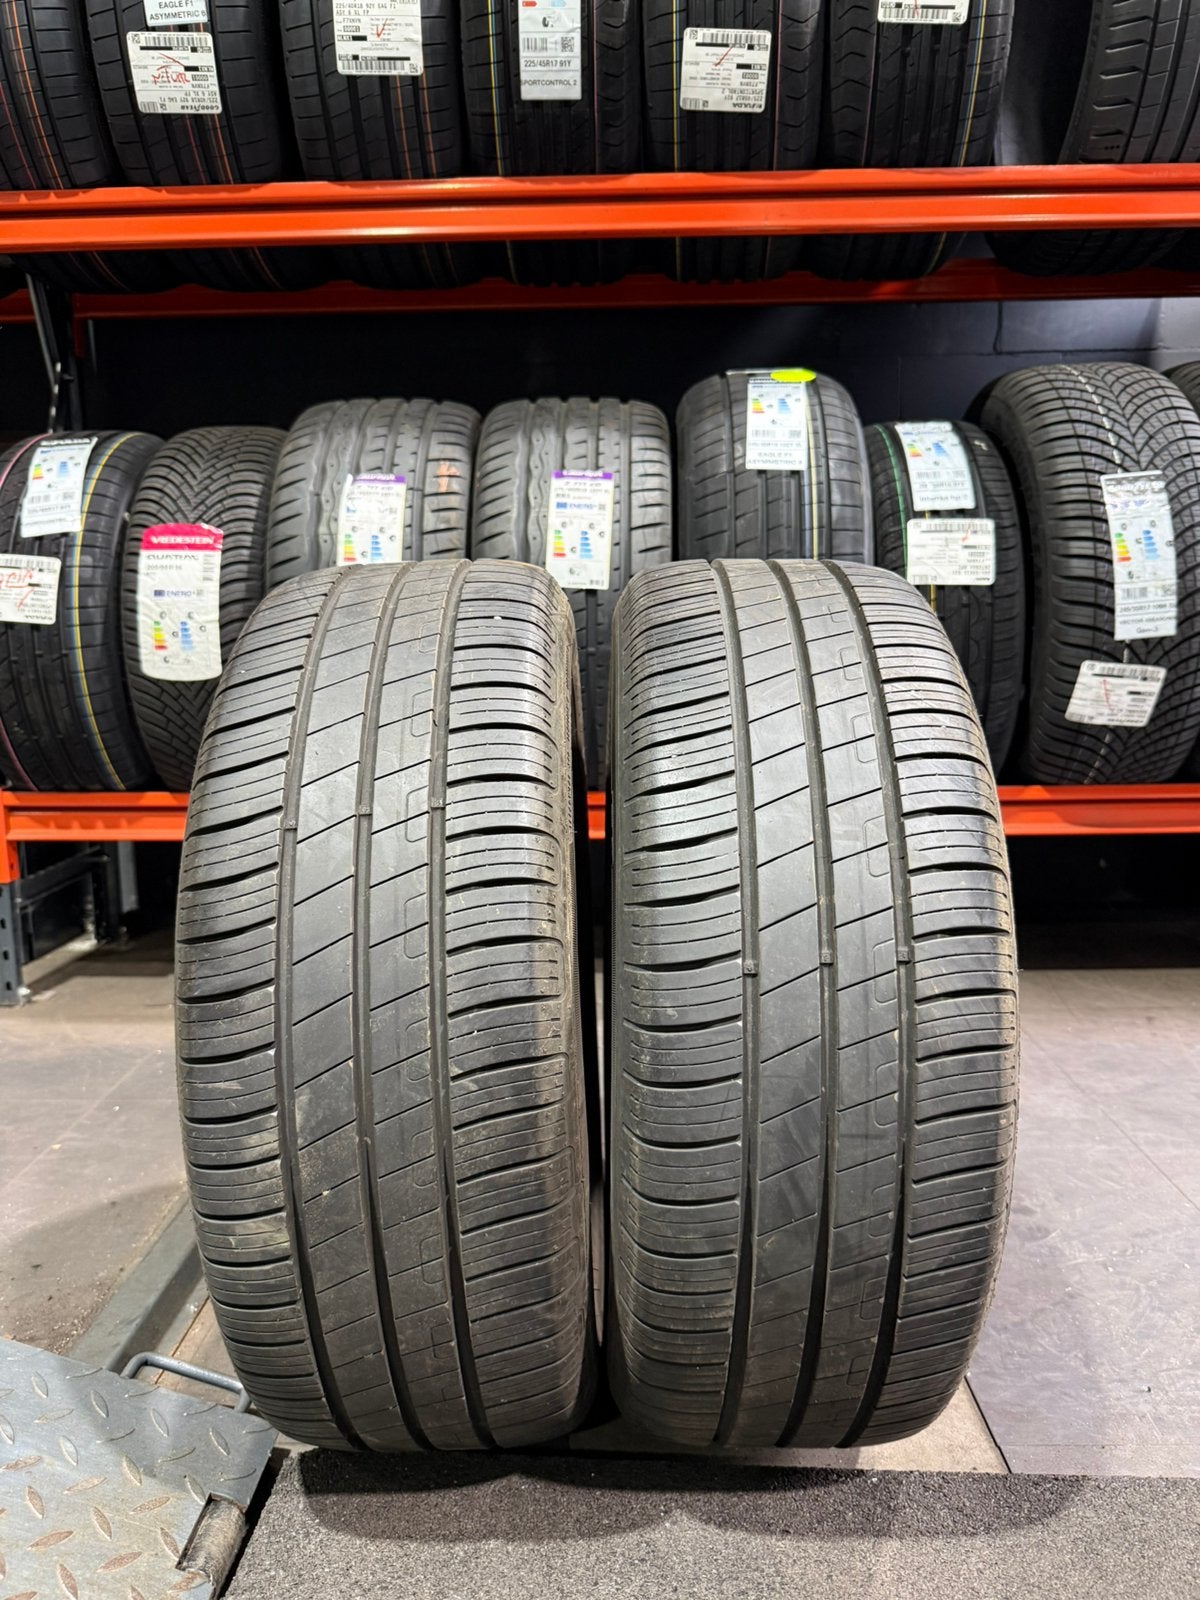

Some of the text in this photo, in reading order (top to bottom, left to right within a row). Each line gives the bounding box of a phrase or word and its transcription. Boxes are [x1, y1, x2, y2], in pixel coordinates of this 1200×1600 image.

[158, 1, 183, 9] EAGLE
[149, 10, 202, 21] ASYMMETRIC
[180, 103, 219, 112] GOODYEAR
[151, 535, 215, 545] VREDESTEIN
